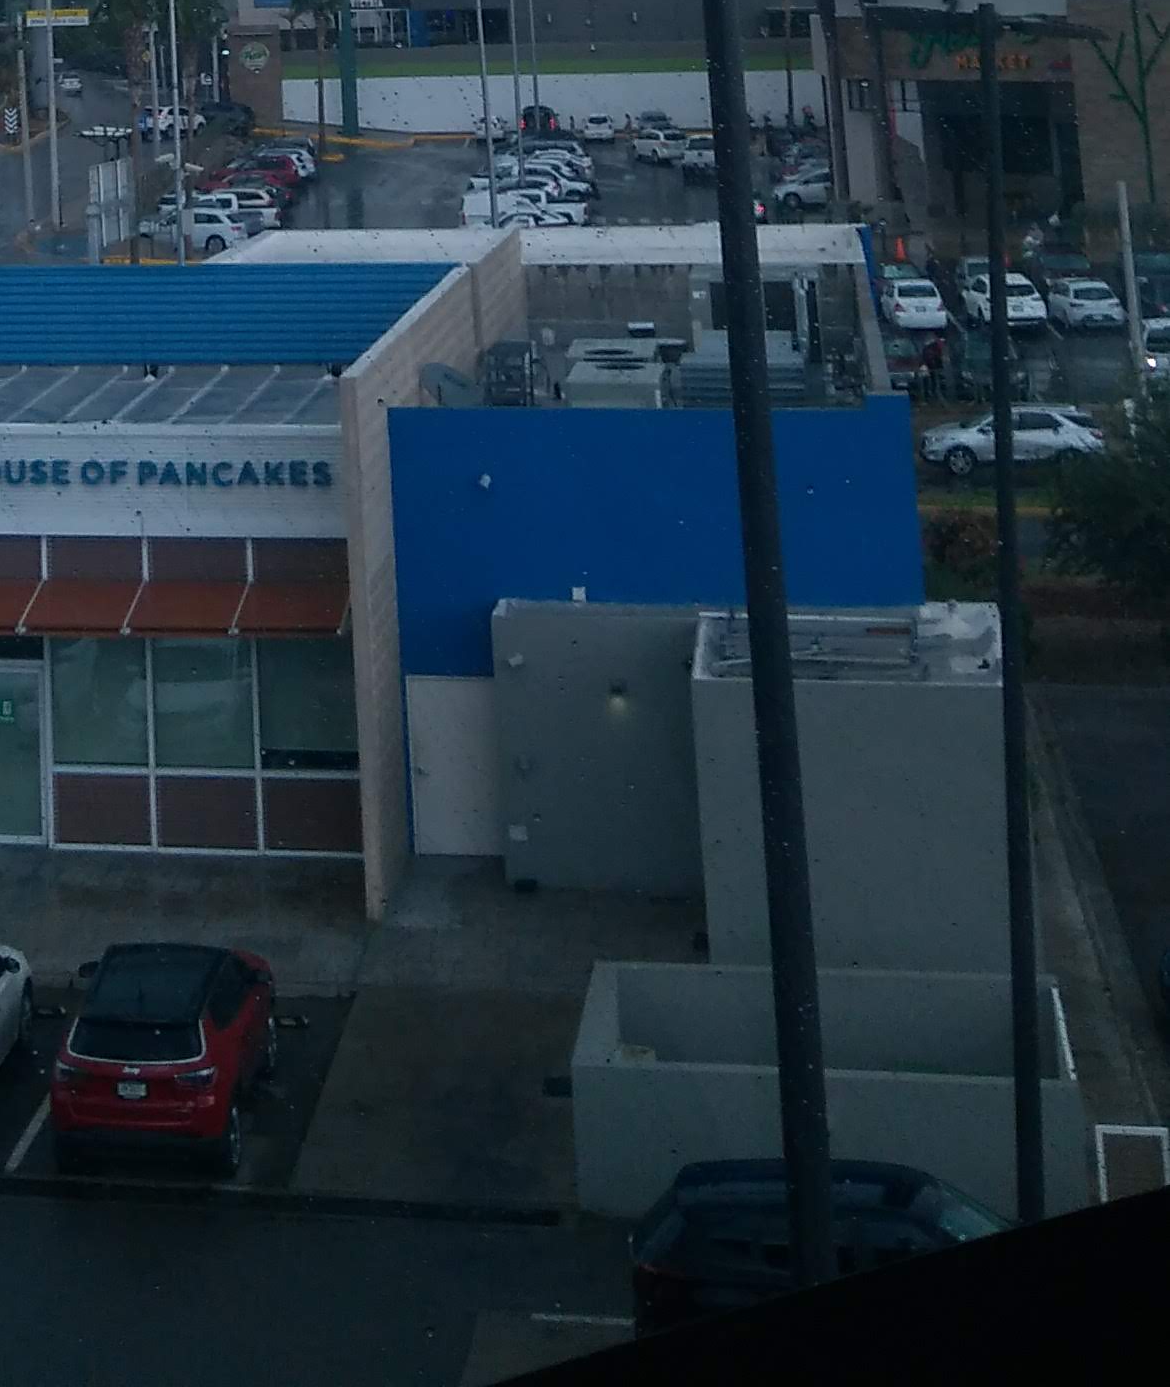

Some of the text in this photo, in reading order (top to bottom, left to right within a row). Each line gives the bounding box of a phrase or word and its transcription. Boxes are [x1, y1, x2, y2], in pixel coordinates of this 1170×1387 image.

[955, 54, 1031, 71] MAKET
[80, 459, 129, 486] OF
[137, 459, 333, 487] PANCAKES
